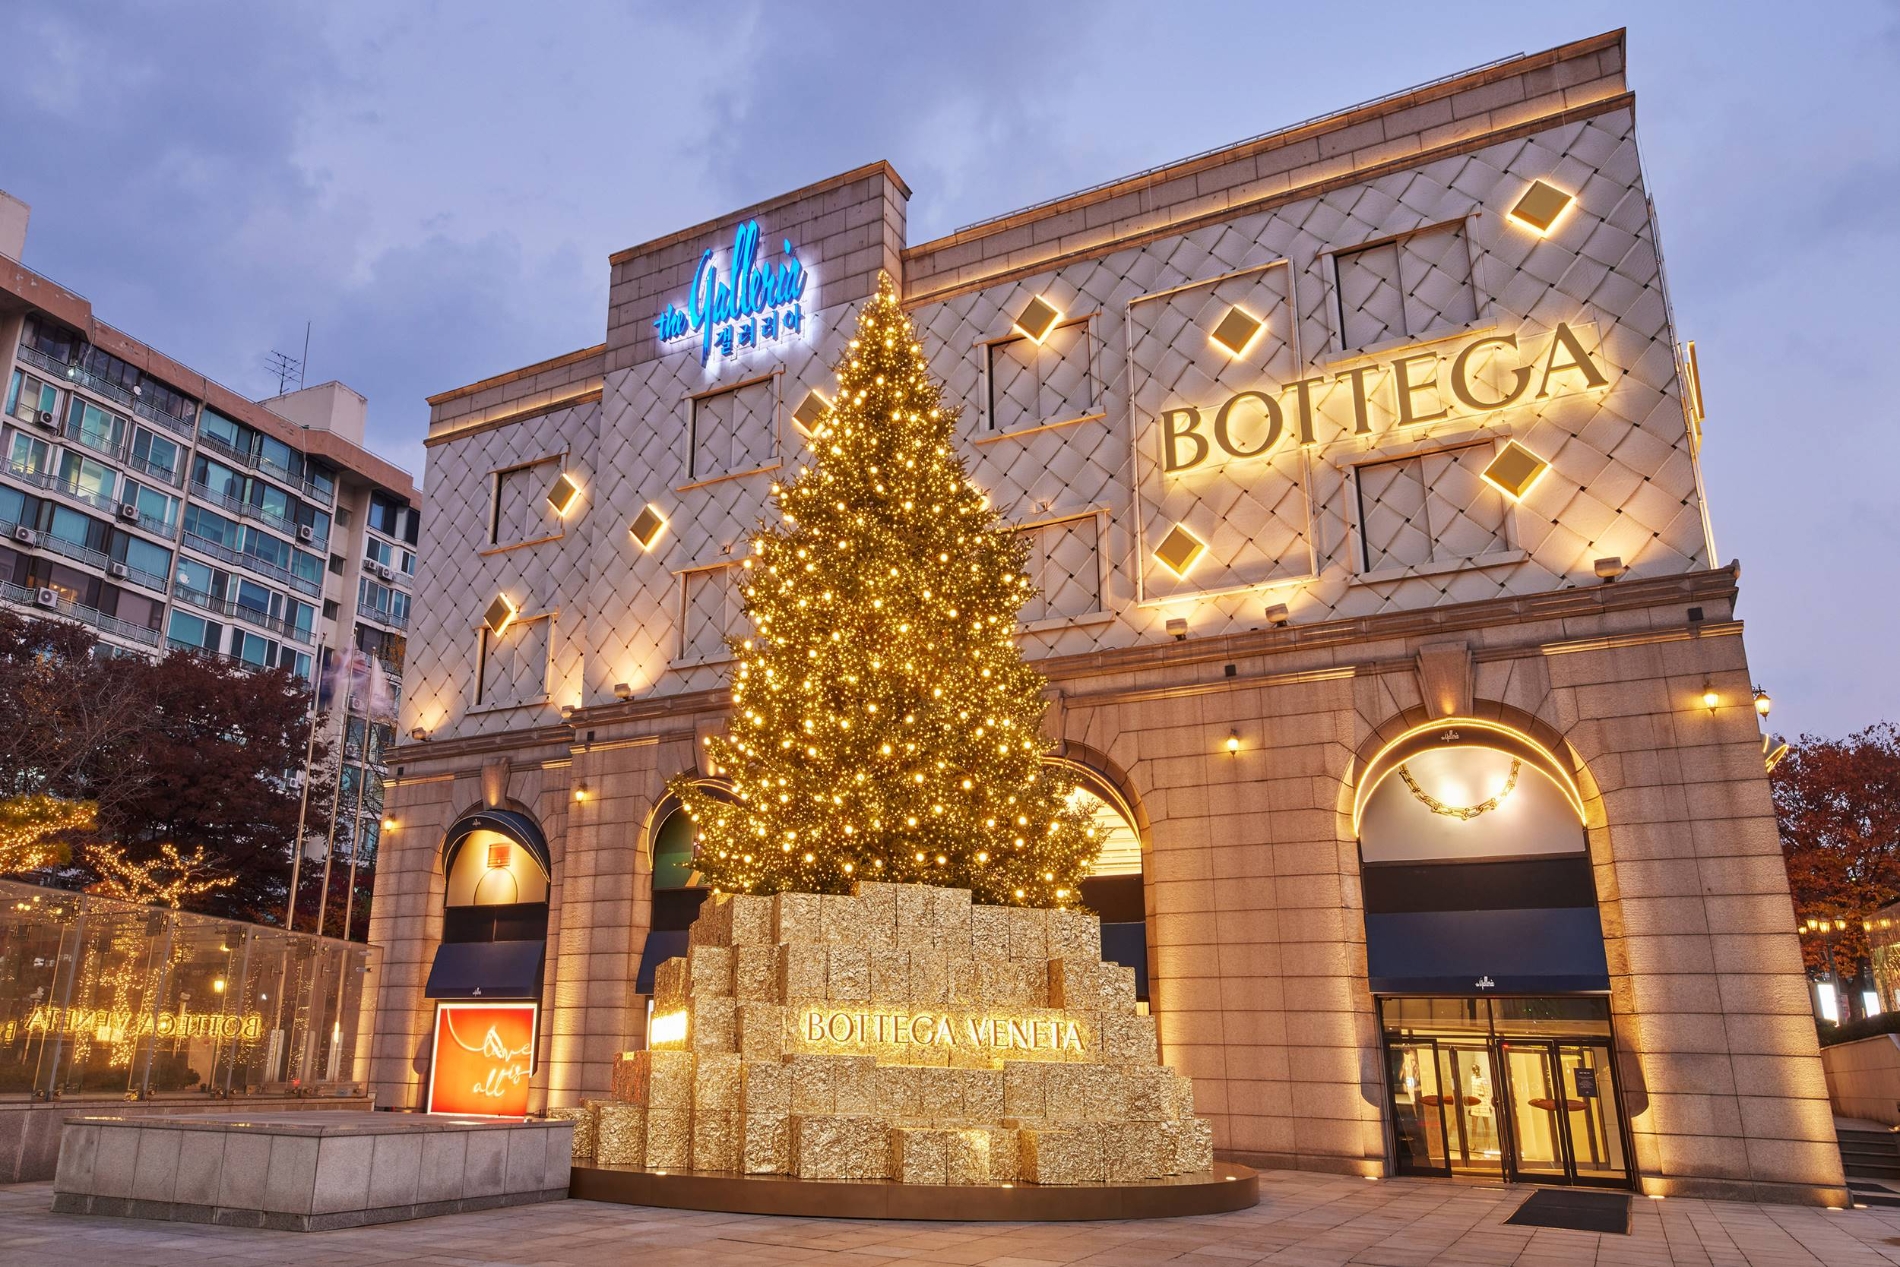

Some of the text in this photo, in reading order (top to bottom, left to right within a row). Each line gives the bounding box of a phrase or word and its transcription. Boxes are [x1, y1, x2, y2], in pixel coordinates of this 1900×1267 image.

[654, 218, 808, 369] the Galleria
[715, 303, 806, 358] 갤러리아
[1160, 321, 1610, 475] BOTTEGA
[806, 1011, 1086, 1051] BOTTEGA VENETA
[472, 1068, 505, 1098] all
